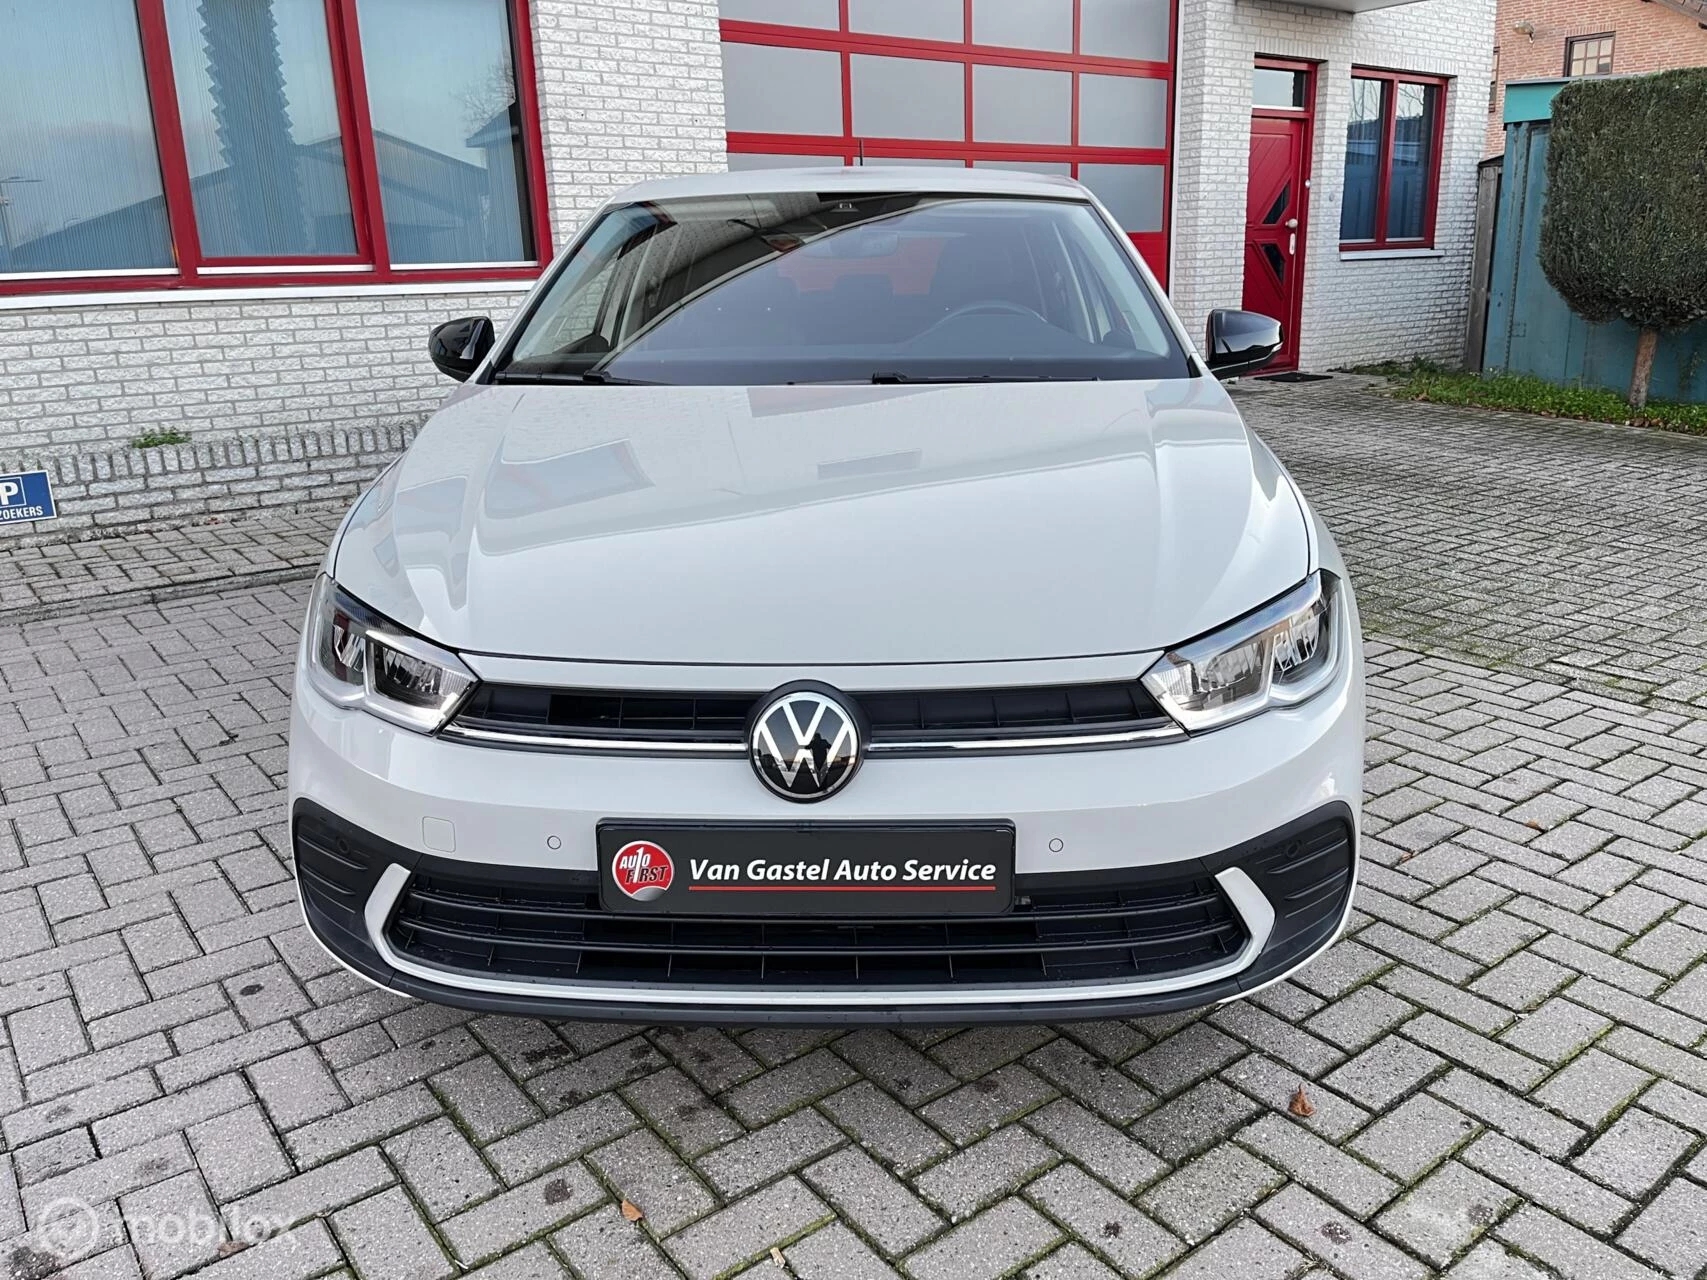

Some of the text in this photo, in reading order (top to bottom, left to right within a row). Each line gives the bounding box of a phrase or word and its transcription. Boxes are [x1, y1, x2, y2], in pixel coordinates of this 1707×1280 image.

[0, 481, 19, 506] P
[690, 858, 997, 881] Van Gastel Auto Service
